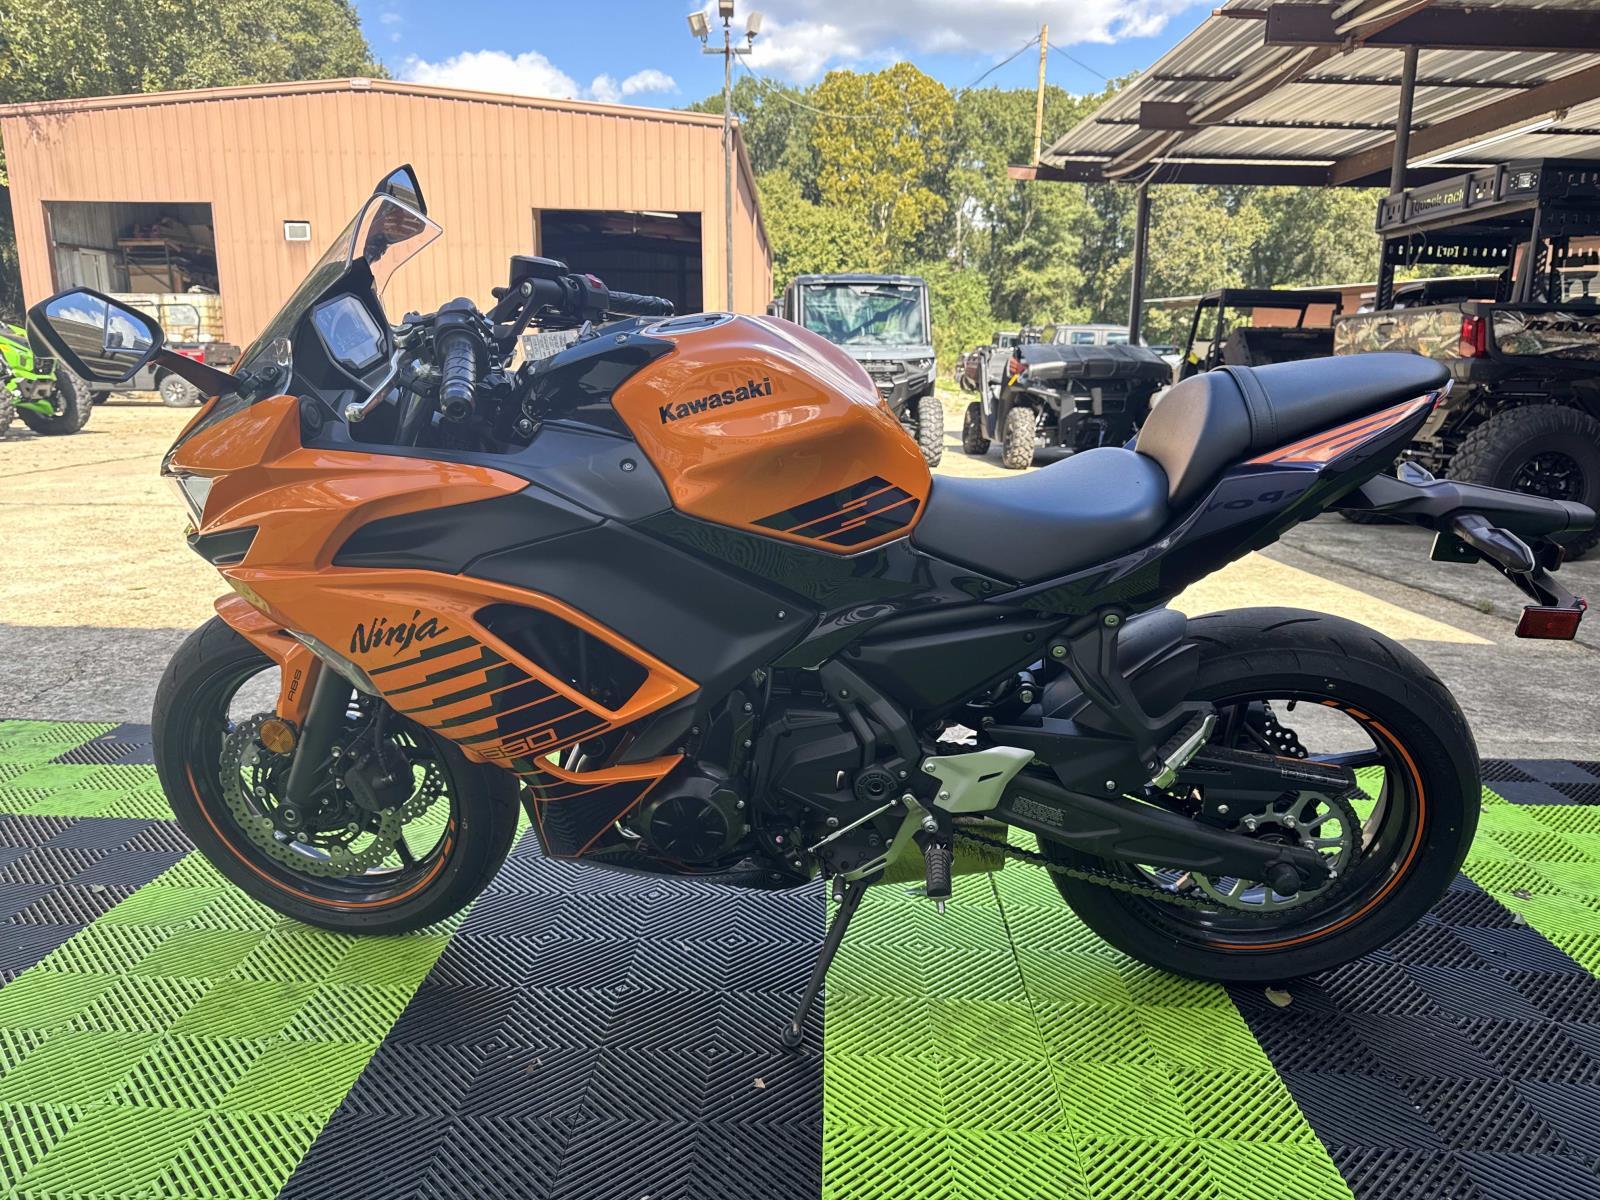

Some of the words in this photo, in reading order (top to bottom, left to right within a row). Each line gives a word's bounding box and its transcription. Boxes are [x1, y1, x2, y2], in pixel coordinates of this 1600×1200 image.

[659, 377, 772, 425] Kawasaki
[350, 609, 449, 657] Ninja
[287, 669, 302, 702] ABS
[480, 727, 558, 760] 650
